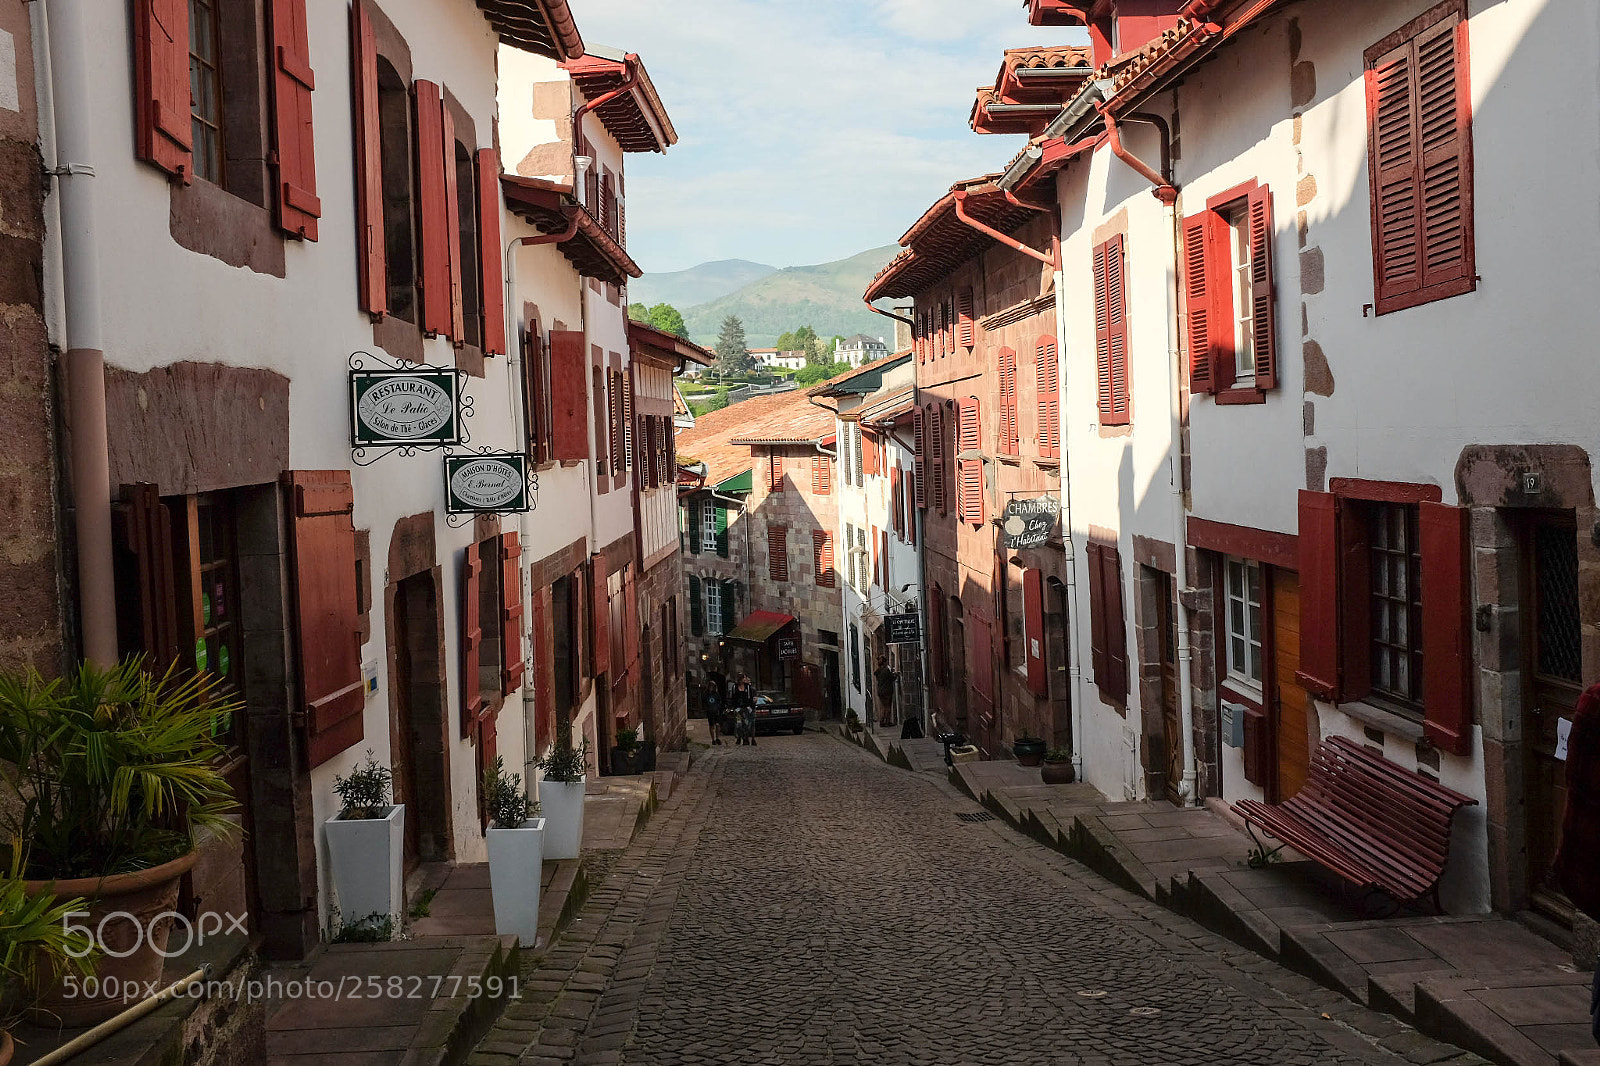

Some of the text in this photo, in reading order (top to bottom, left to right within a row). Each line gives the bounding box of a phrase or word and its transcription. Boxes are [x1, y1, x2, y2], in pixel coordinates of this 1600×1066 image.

[372, 382, 437, 401] RESTAURANT
[381, 402, 396, 414] Le
[373, 416, 388, 430] Salon
[391, 423, 399, 432] de
[401, 424, 411, 433] Thé
[418, 417, 438, 431] Glaces
[461, 464, 485, 478] MAISON
[1526, 477, 1535, 489] 19
[1008, 502, 1058, 514] CHAMBRES
[1028, 519, 1048, 531] Chez
